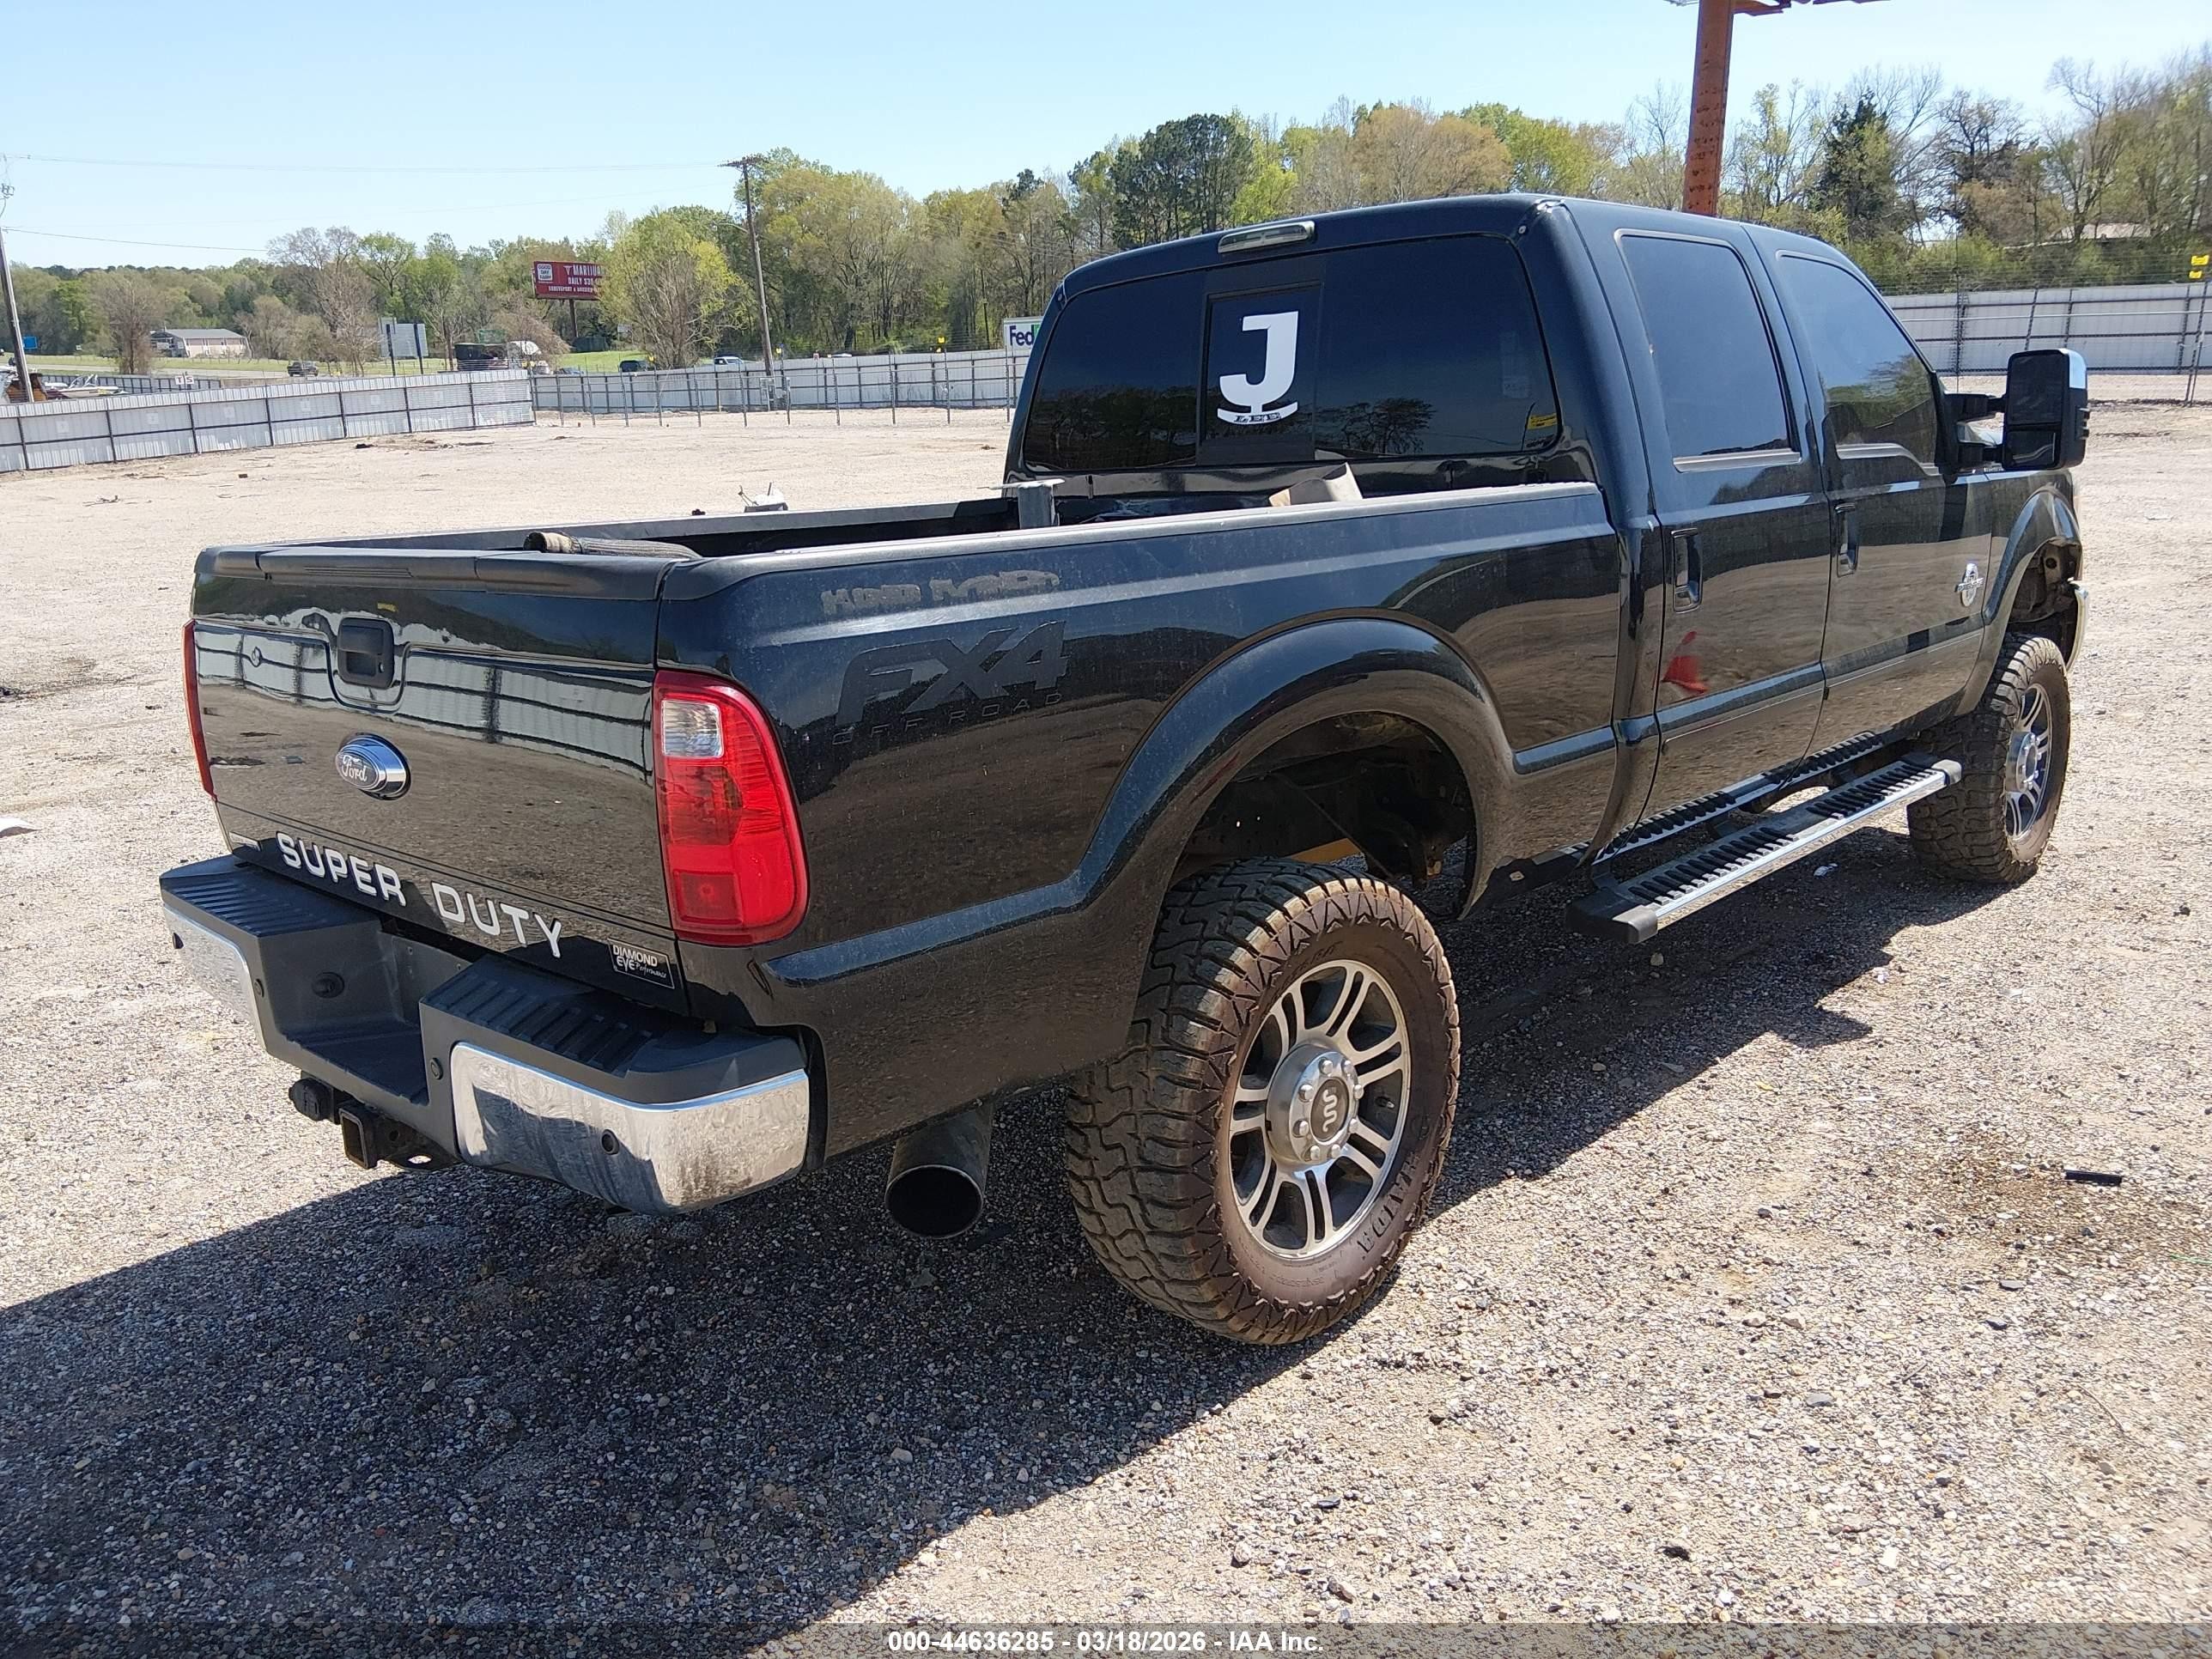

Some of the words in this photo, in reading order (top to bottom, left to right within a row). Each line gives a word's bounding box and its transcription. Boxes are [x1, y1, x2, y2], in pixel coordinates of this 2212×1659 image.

[1219, 310, 1298, 407] J
[836, 620, 1071, 726] FX4
[948, 692, 1063, 724] ROAD
[341, 754, 368, 782] Ford
[275, 830, 408, 907] SUPER
[431, 880, 562, 959] DUTY
[612, 945, 658, 967] DIAMOND
[617, 956, 635, 972] EYE
[635, 961, 667, 979] Performance
